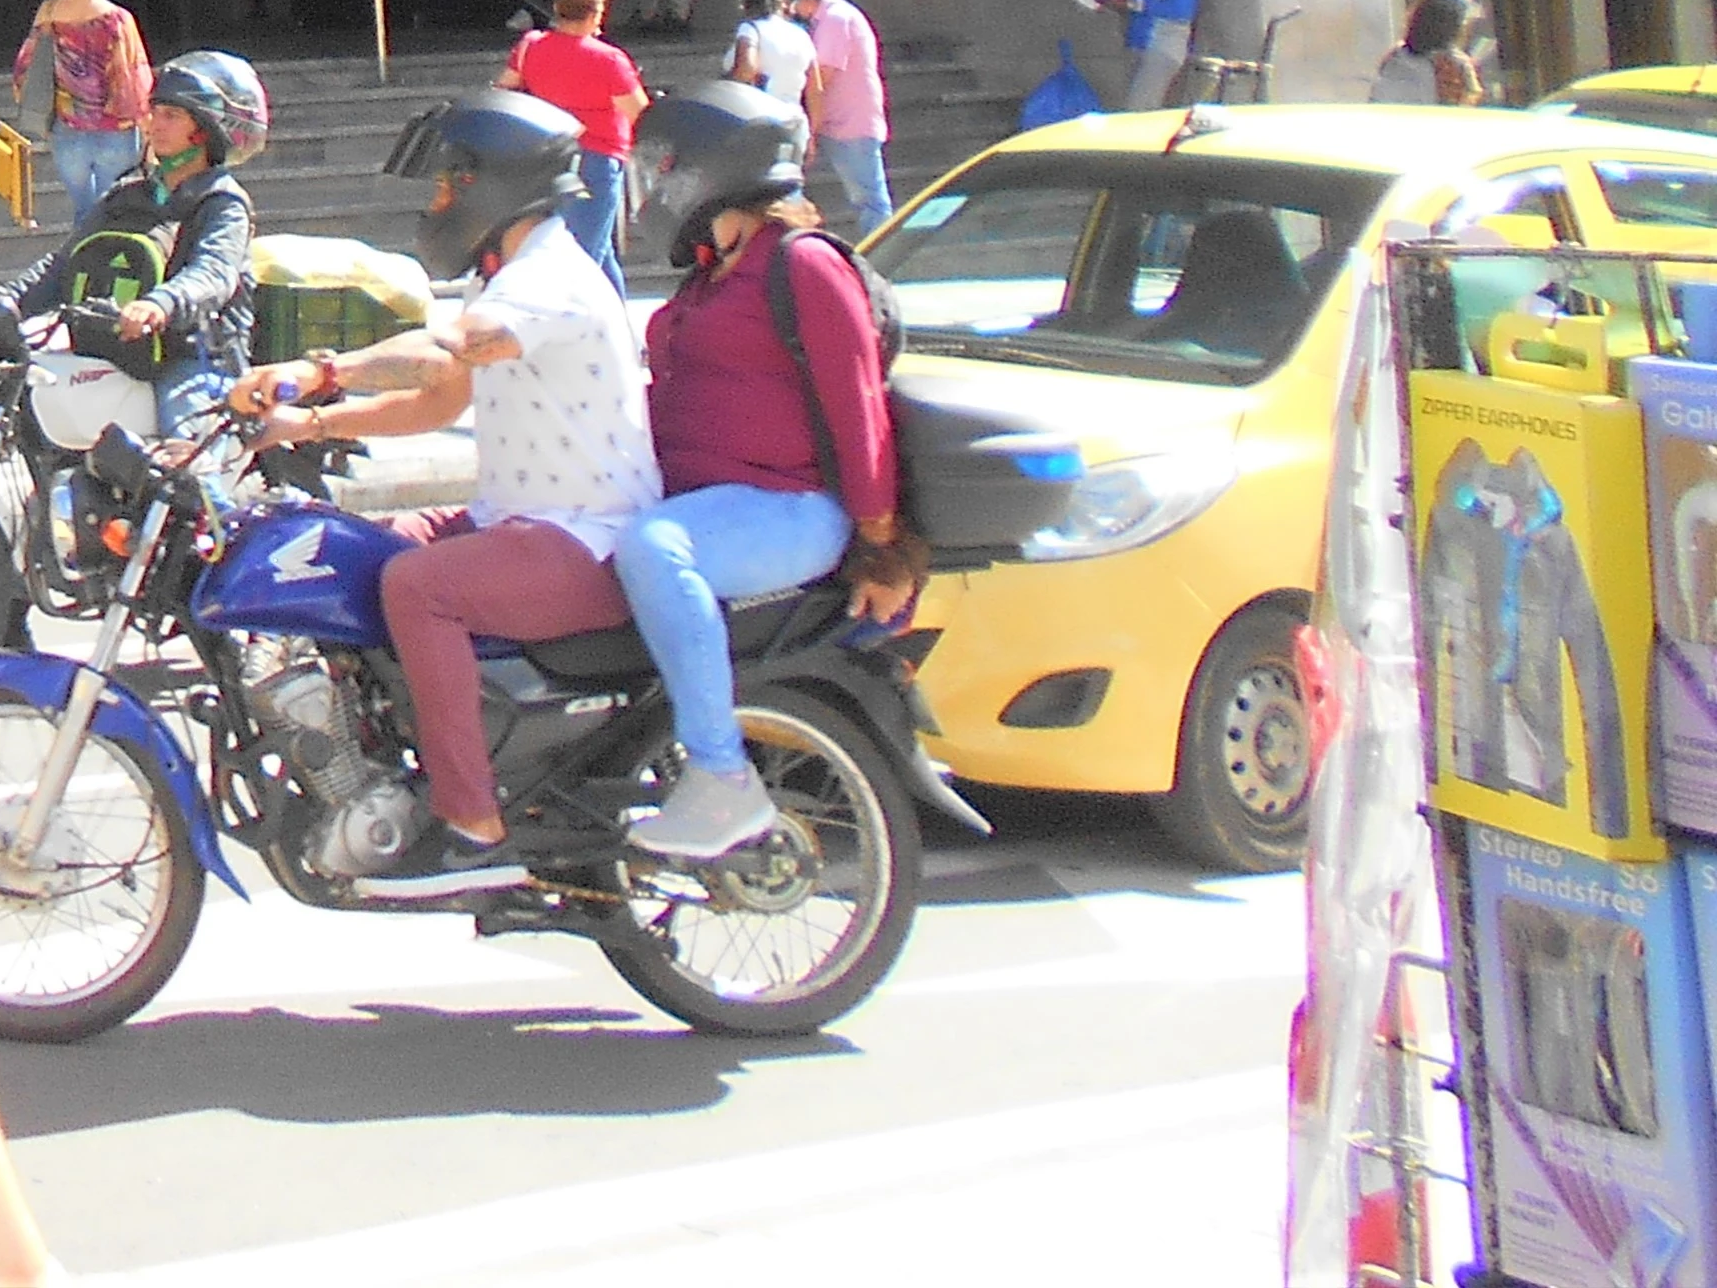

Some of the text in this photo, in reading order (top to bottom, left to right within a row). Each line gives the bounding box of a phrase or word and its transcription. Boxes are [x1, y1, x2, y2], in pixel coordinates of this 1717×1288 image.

[1420, 397, 1577, 441] ZIPPER EARPHONES
[1477, 827, 1564, 869] Stereo
[1506, 862, 1647, 917] Handsfree
